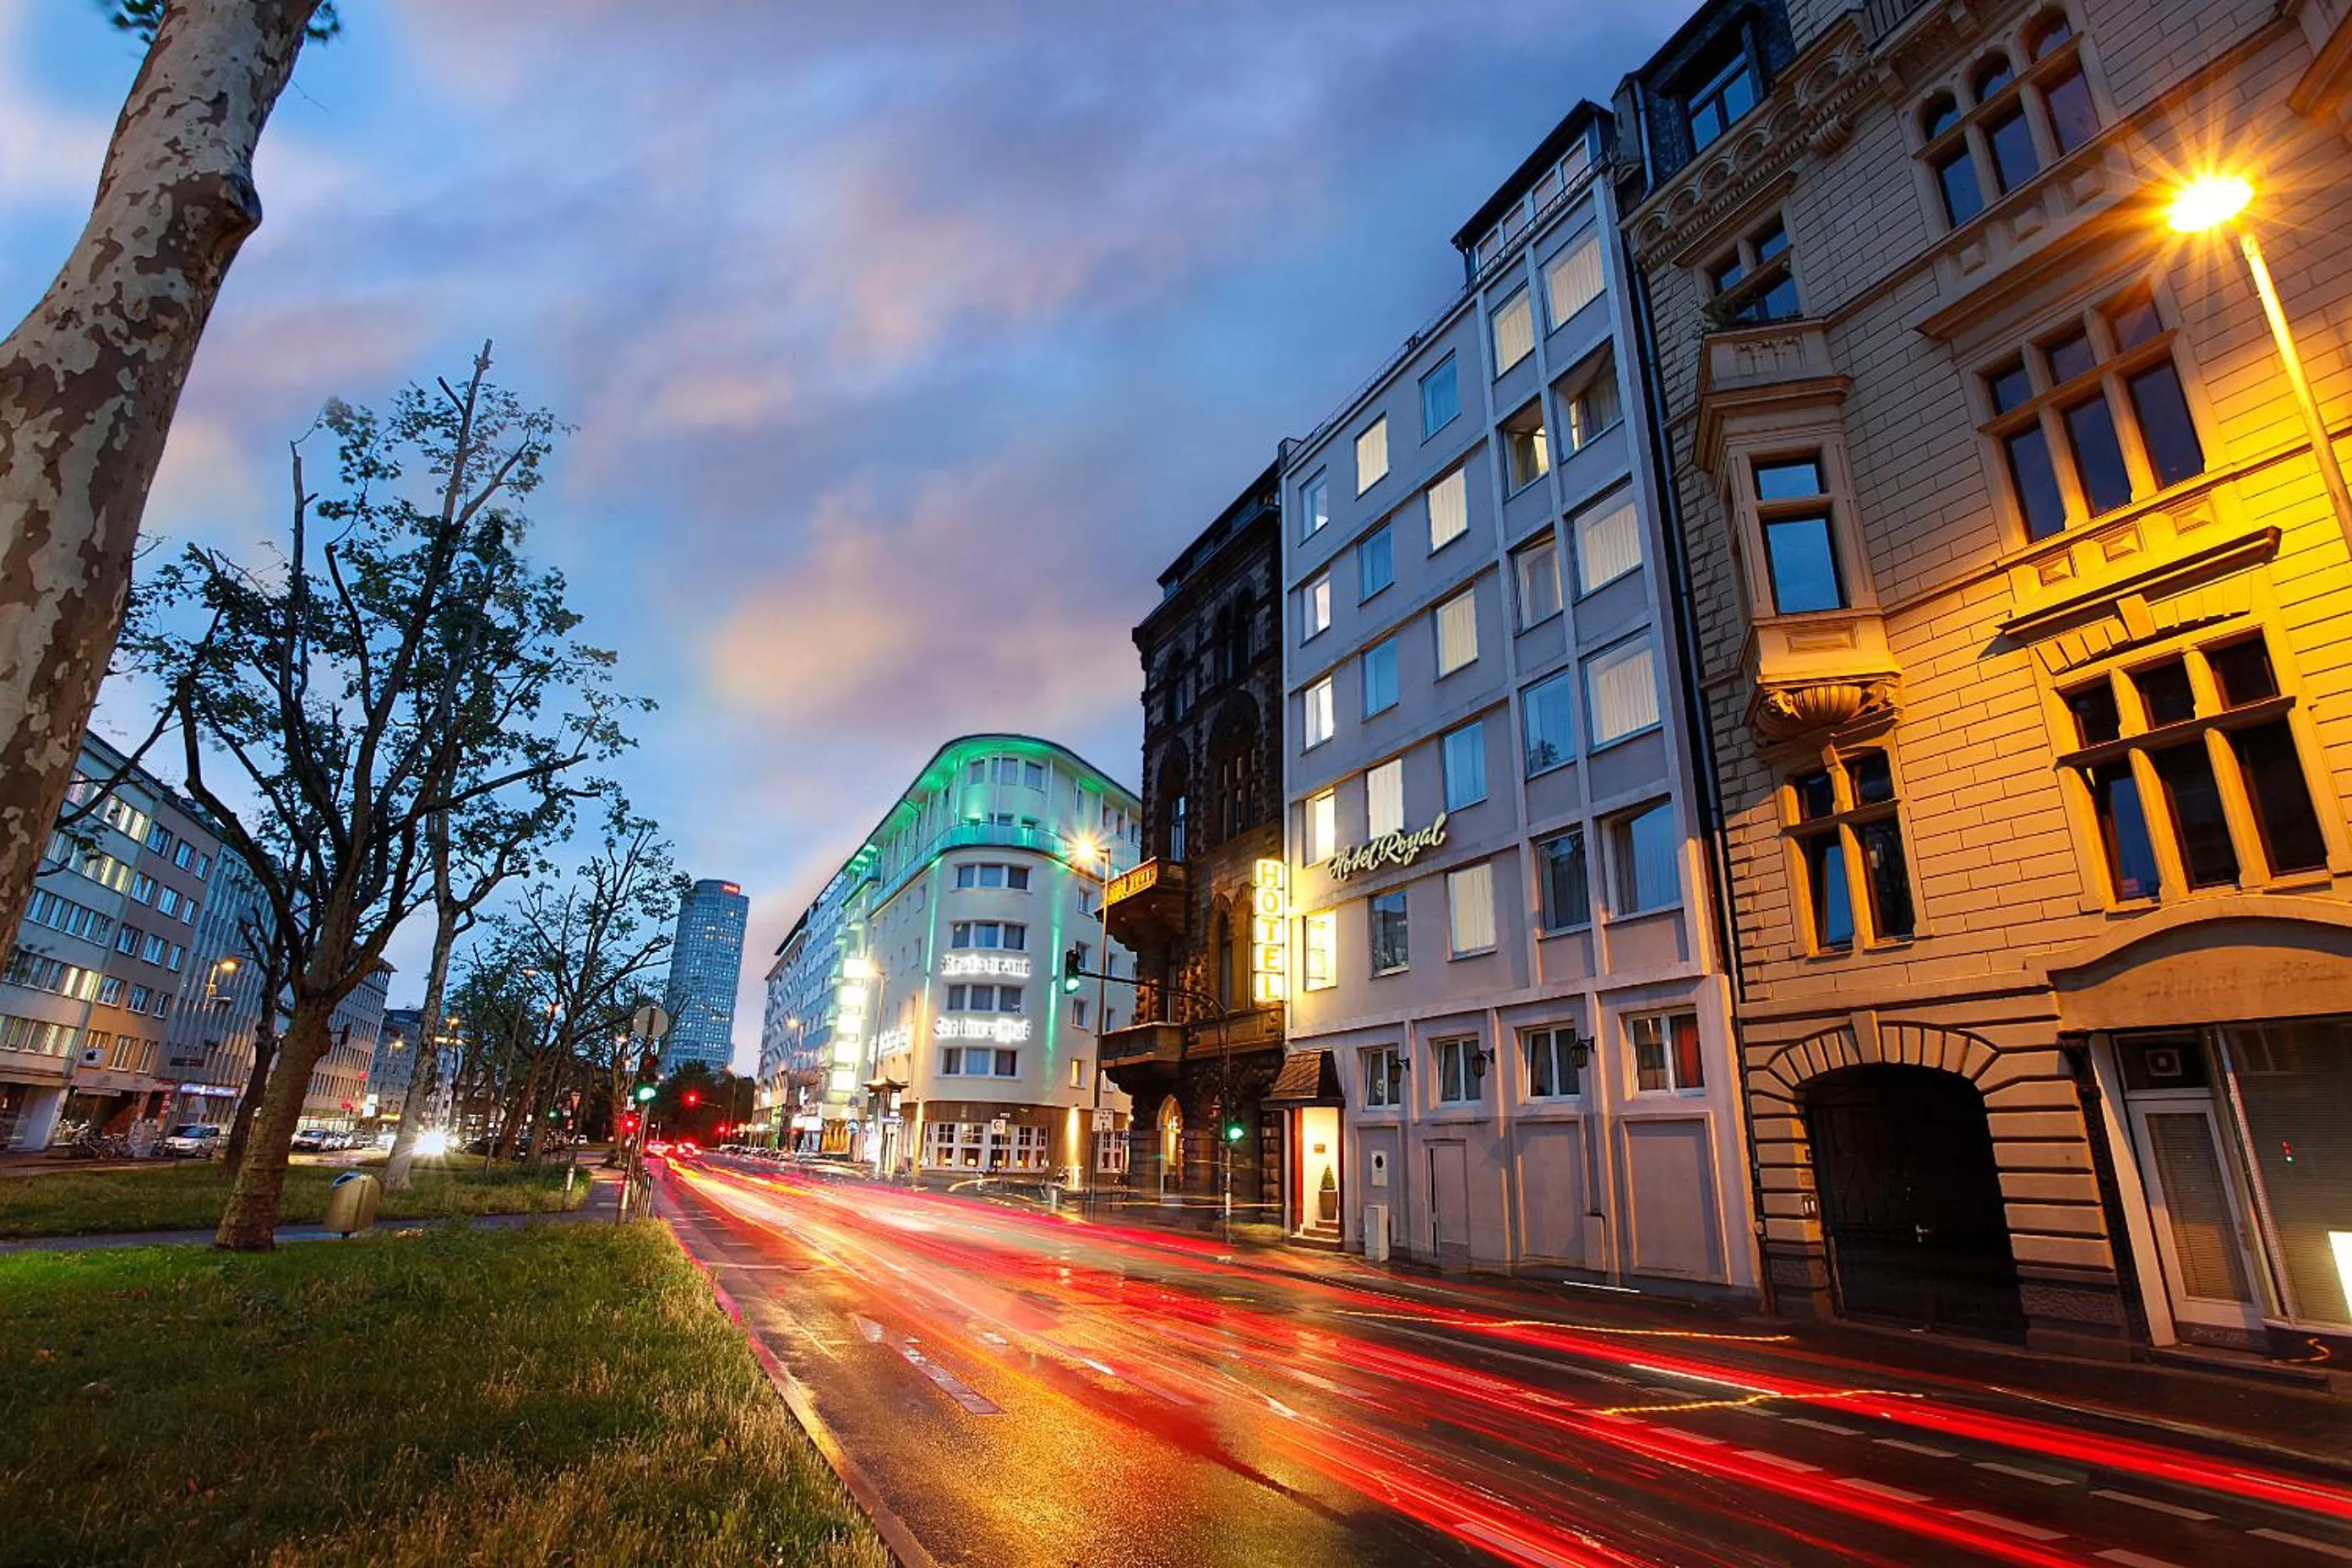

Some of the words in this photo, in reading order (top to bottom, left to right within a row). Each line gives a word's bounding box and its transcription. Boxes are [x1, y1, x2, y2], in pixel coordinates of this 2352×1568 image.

[1329, 839, 1379, 881] Hotel
[1378, 812, 1447, 866] Royal
[1260, 862, 1281, 999] HOTEL
[941, 955, 1031, 977] Restaurant
